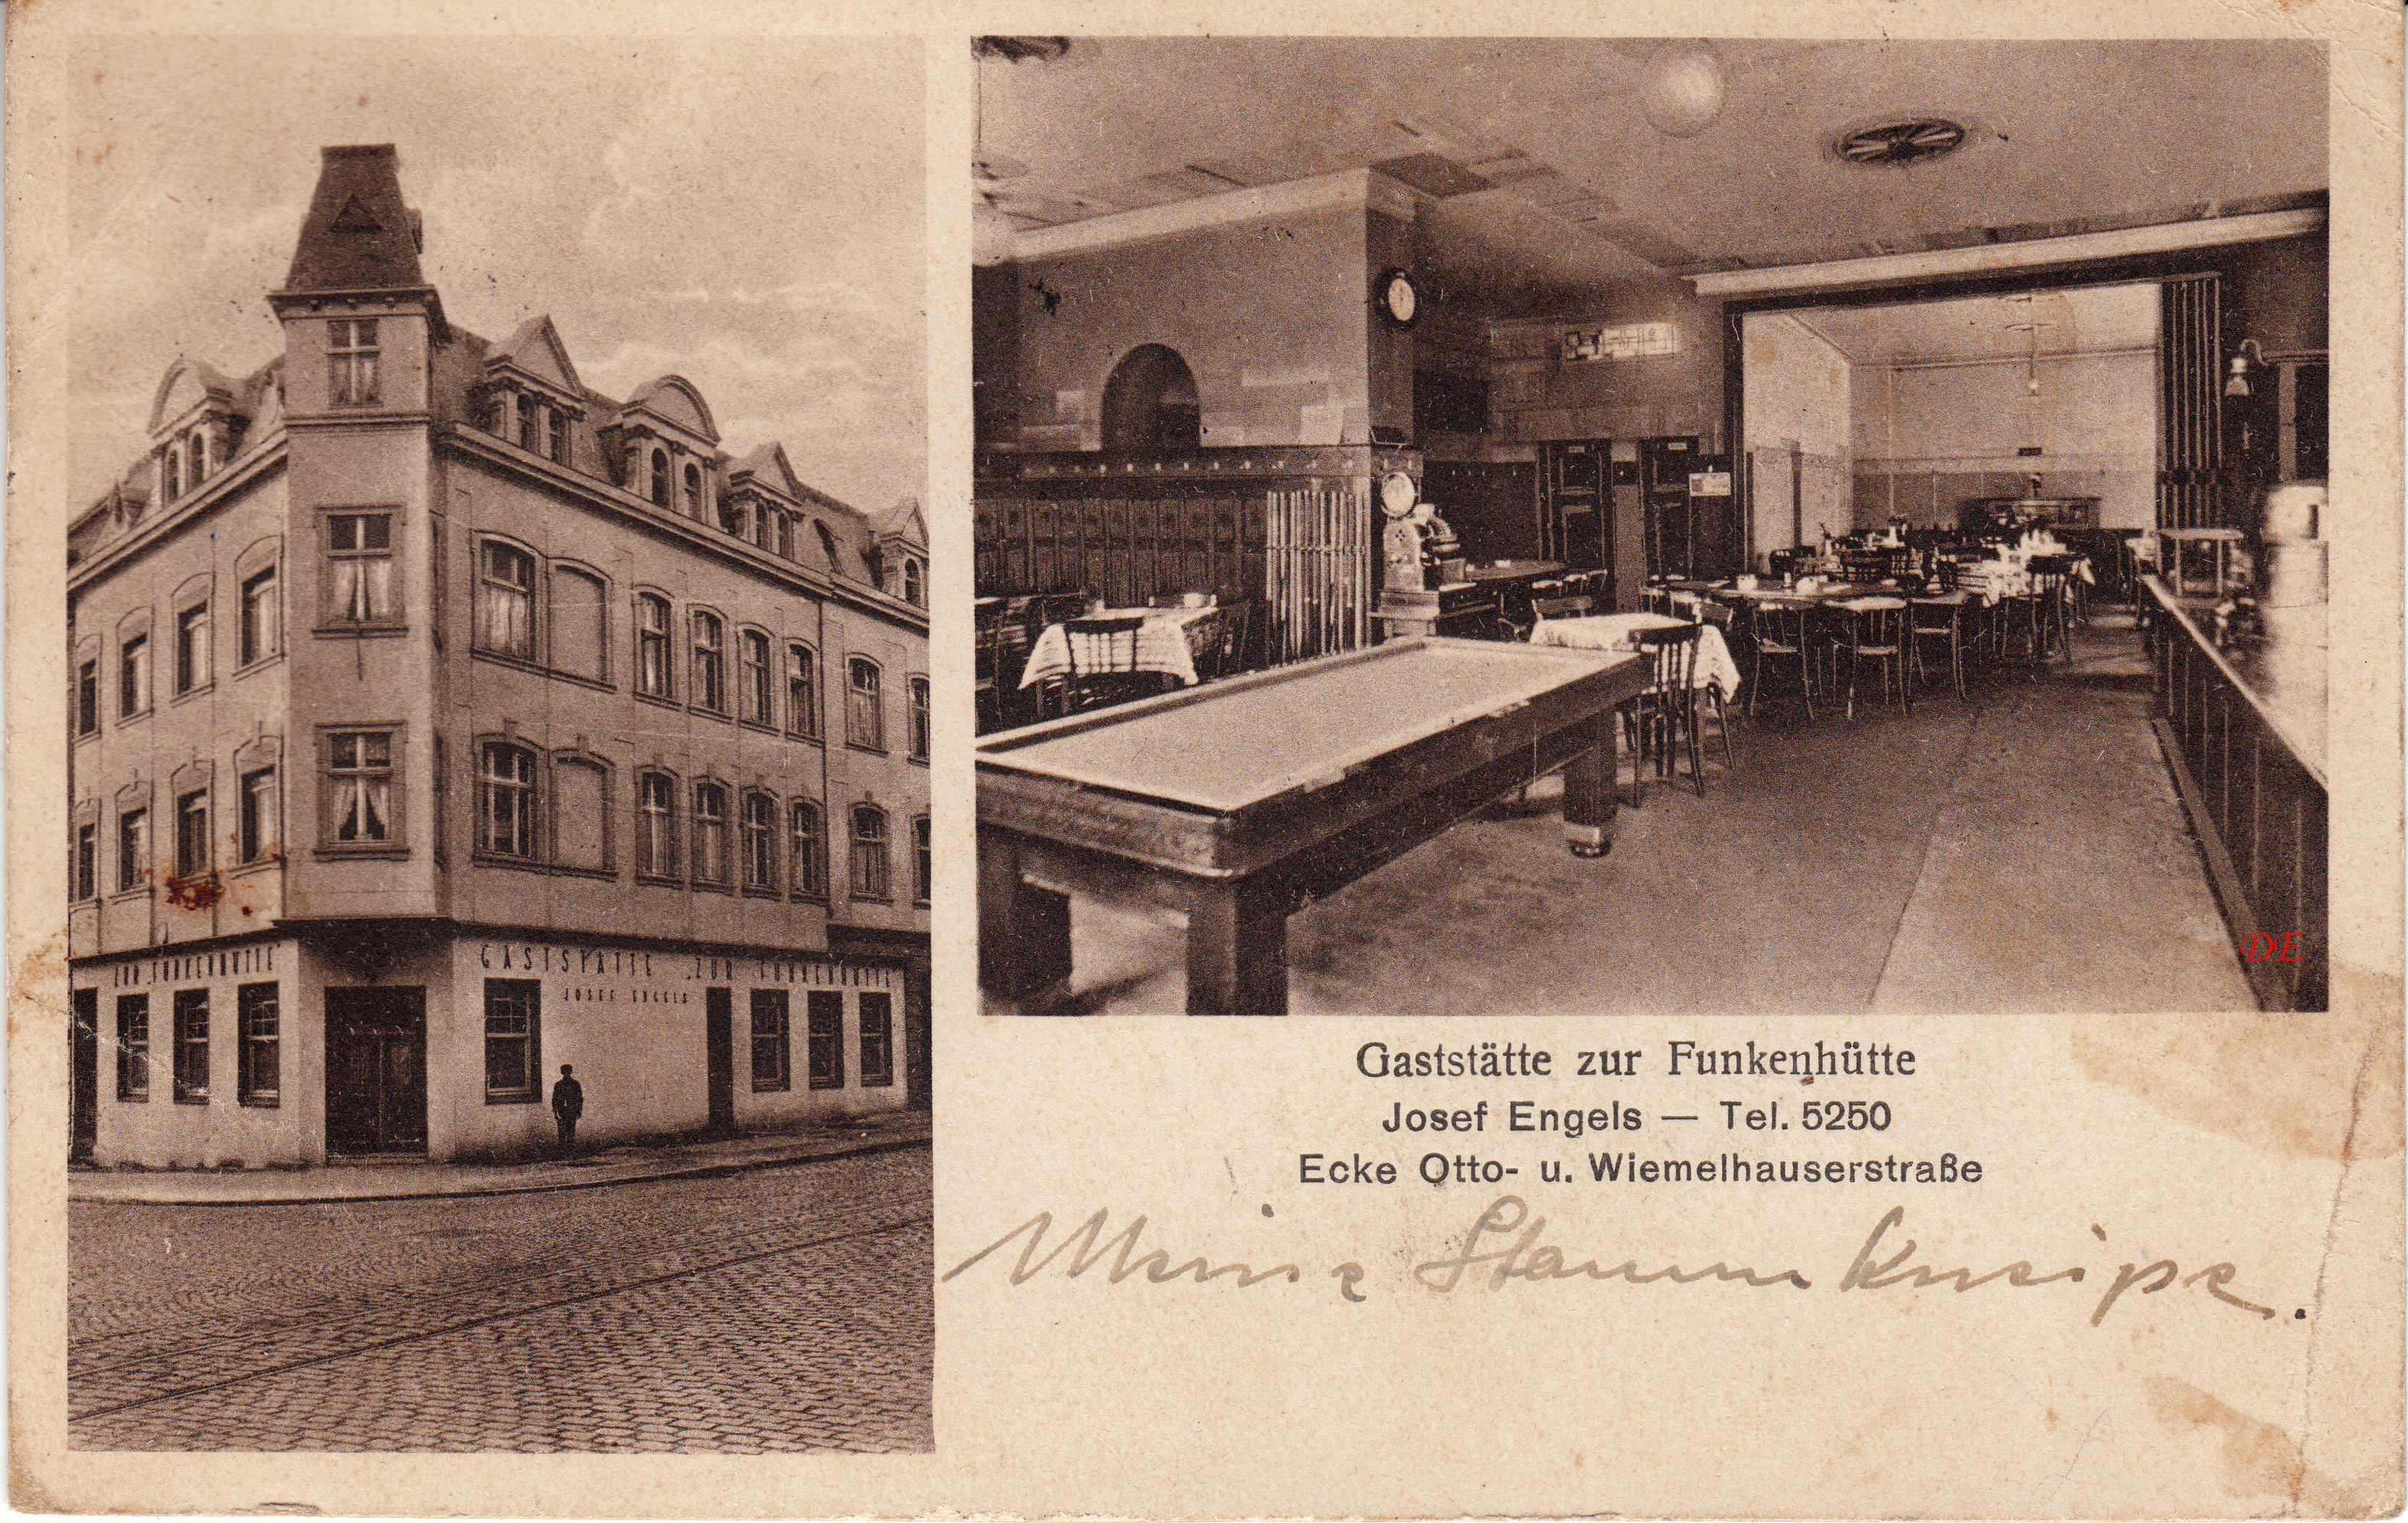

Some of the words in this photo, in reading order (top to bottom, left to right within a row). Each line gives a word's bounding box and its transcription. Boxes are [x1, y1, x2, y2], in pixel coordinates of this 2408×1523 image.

[1356, 1042, 1551, 1078] Gaststätte
[1577, 1050, 1642, 1076] zur
[1668, 1040, 1916, 1078] Funkenhütte
[1382, 1101, 1488, 1133] Josef
[1509, 1101, 1642, 1138] Engels
[1719, 1101, 1788, 1131] Tel.
[1802, 1101, 1892, 1131] 5250
[1300, 1153, 1397, 1184] Ecke
[1419, 1153, 1519, 1184] Otto-
[1540, 1161, 1572, 1183] u.
[1588, 1152, 1983, 1184] Wiemelhauserstraße
